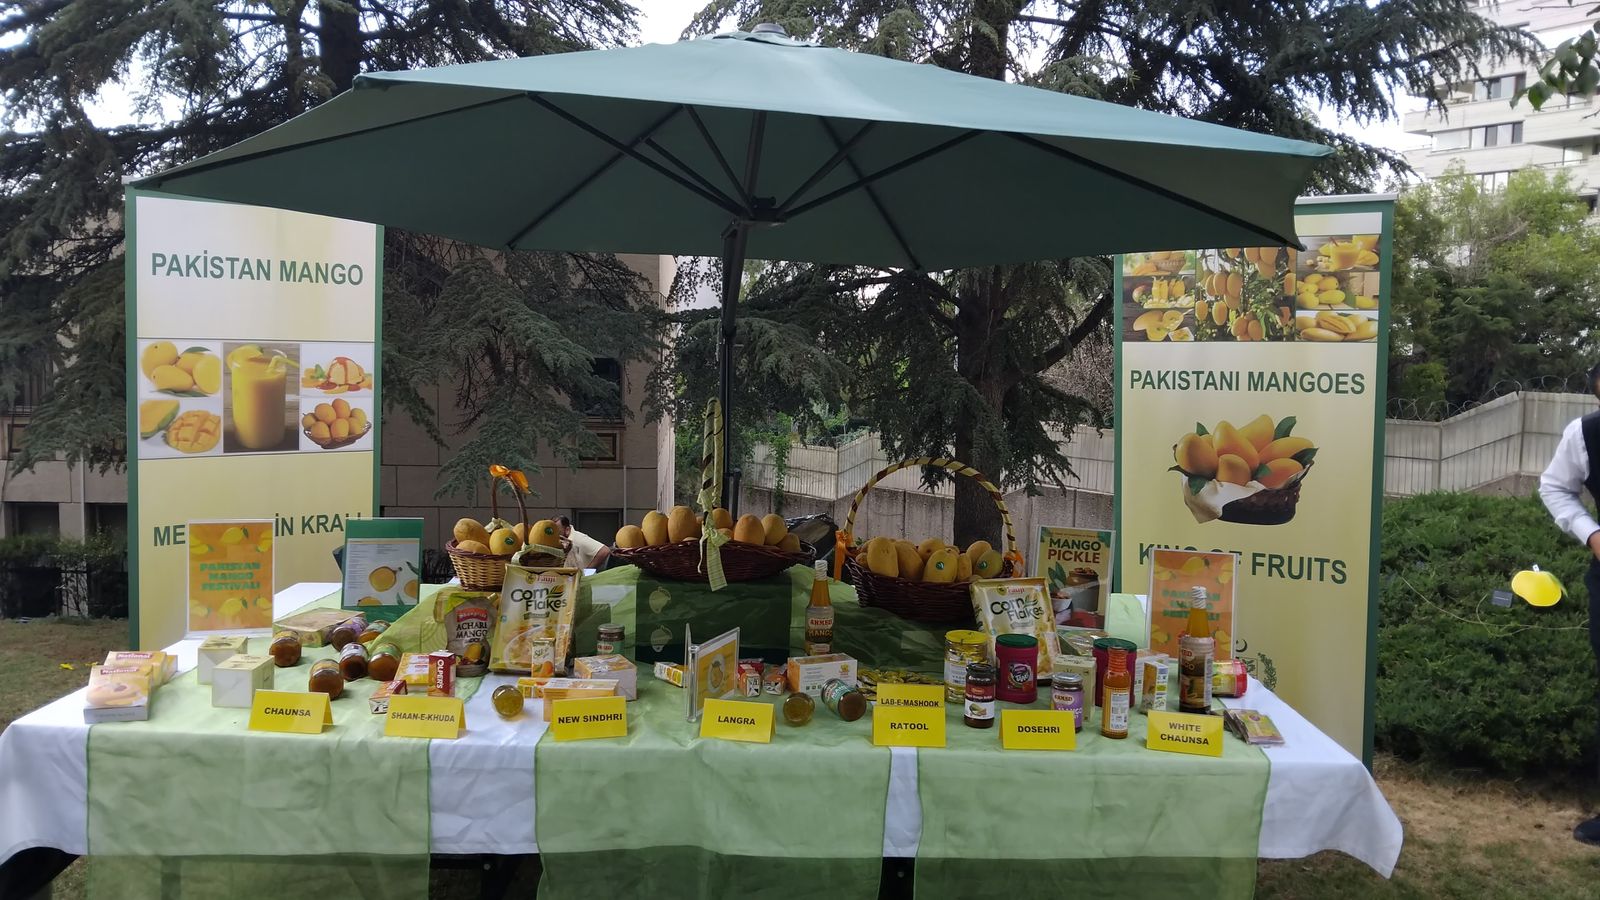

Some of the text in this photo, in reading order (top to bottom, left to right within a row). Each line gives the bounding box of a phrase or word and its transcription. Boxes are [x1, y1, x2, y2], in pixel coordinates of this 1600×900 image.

[152, 250, 364, 285] PAKİSTAN MANGO
[1131, 370, 1365, 394] PAKISTANI MANGOES
[302, 512, 361, 535] KRA
[1049, 538, 1102, 551] MANGO
[1048, 549, 1100, 564] PICKLE
[1252, 552, 1347, 585] FRUITS
[511, 588, 549, 602] Corn
[526, 599, 567, 612] Flakes
[990, 598, 1025, 615] Corn
[1008, 606, 1044, 621] Flakes
[456, 621, 487, 631] ACHARI
[456, 630, 488, 639] MANGO
[881, 698, 939, 707] LAB-E-MASHOOK
[264, 707, 311, 717] CHAUNSA
[391, 711, 455, 722] SHAAN-E-KHUDA
[558, 713, 623, 724] NEW SINDHRI
[718, 715, 756, 725] LANGRA
[890, 722, 929, 730] RATOOL
[1017, 725, 1060, 734] DOSEHRI
[1169, 722, 1201, 732] WHITE
[1160, 733, 1210, 745] CHAUNSA
